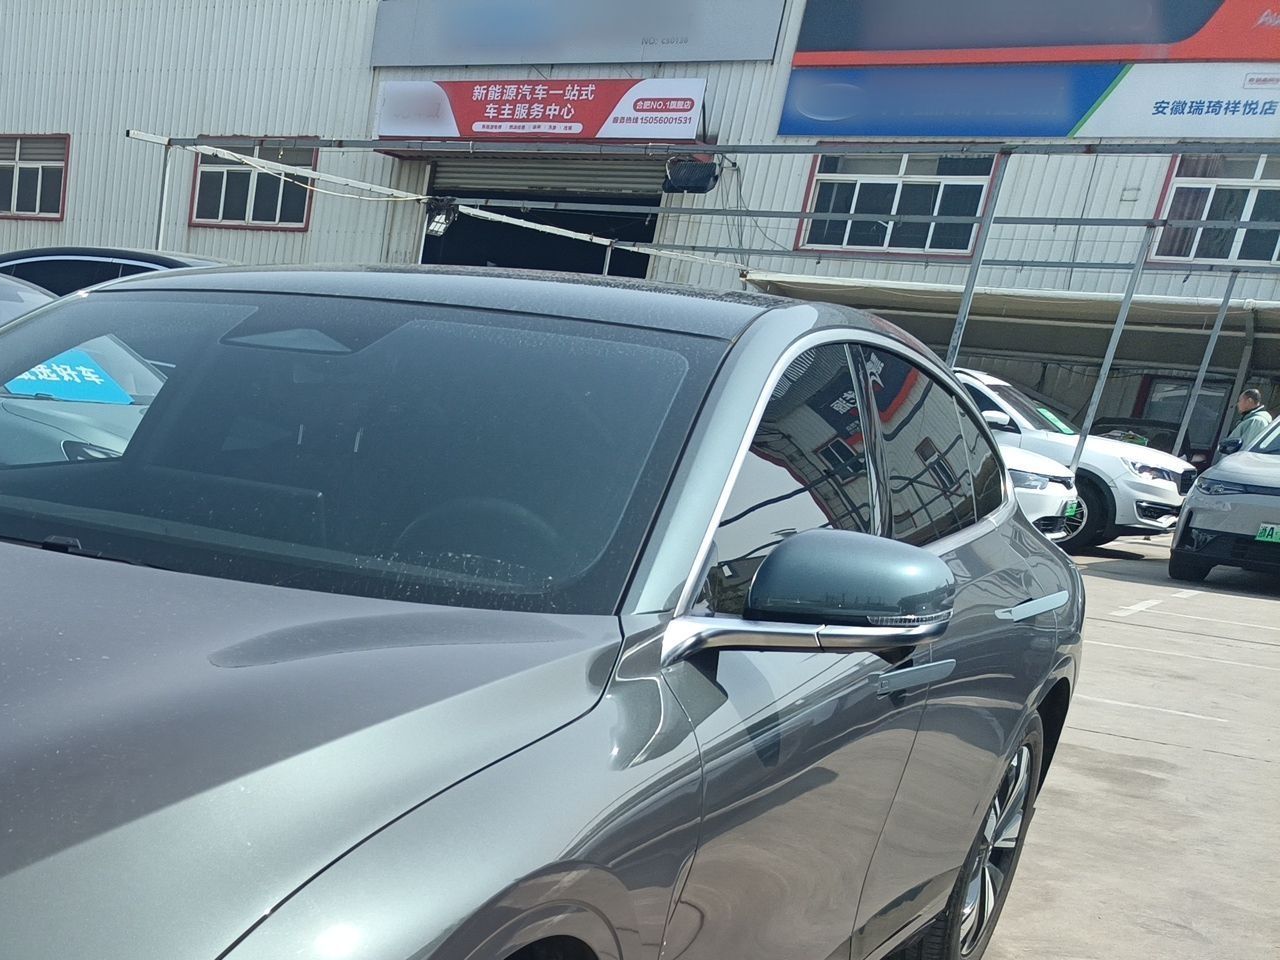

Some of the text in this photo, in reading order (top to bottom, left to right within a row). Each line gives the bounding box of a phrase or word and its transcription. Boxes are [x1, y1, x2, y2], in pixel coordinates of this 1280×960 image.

[472, 84, 596, 100] 新能源汽车一站式
[484, 103, 575, 119] 车主服务中心
[1152, 100, 1280, 116] 安徽瑞琦祥悦店
[640, 116, 692, 124] 15056001531
